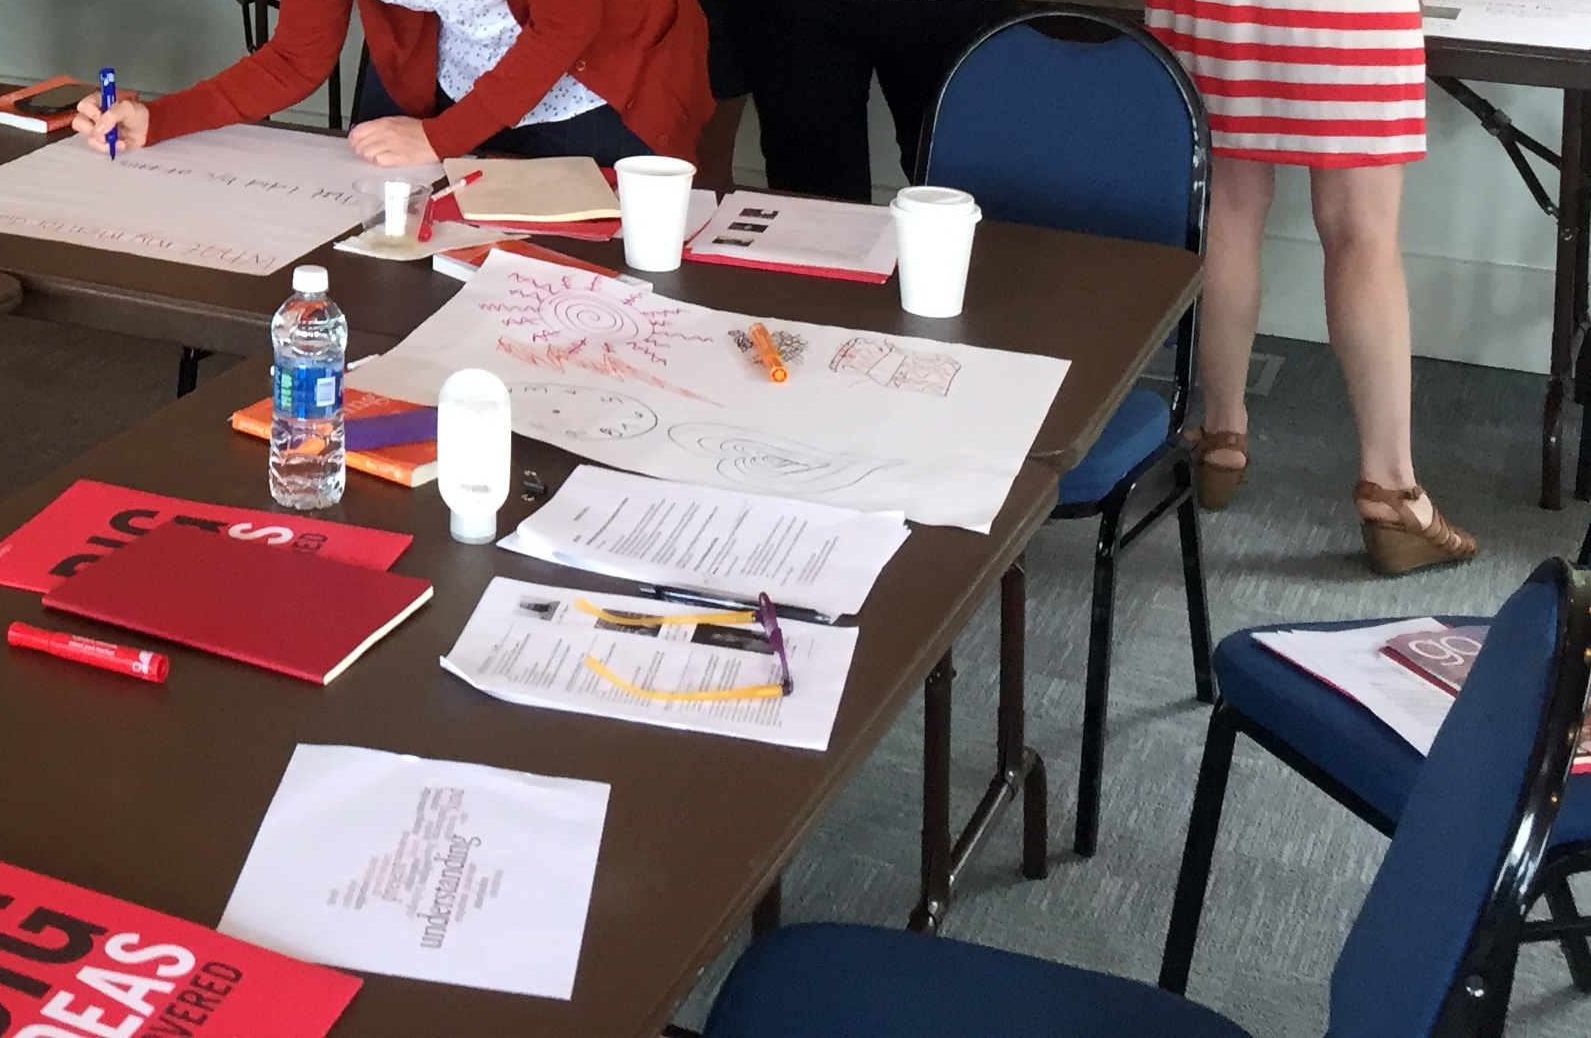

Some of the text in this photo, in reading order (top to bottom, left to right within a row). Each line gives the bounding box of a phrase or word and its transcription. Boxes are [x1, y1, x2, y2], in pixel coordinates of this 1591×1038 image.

[416, 834, 482, 948] understanding
[8, 932, 197, 1038] EAS
[141, 961, 243, 1038] VERED
